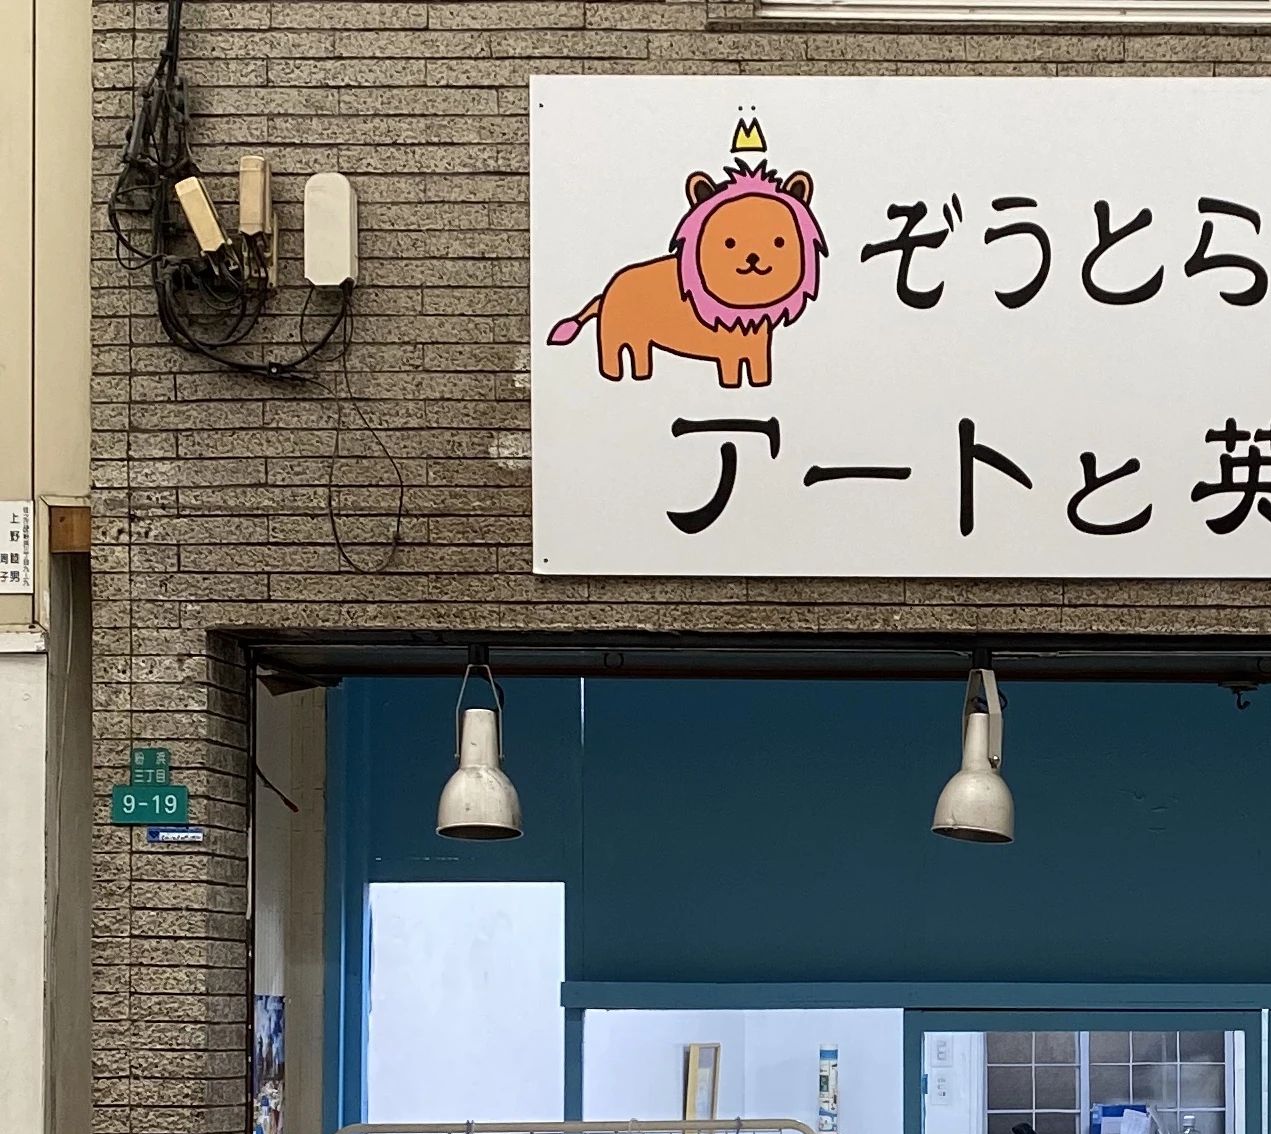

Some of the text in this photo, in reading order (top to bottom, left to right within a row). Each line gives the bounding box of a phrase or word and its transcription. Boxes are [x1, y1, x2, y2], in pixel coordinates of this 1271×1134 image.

[134, 769, 166, 783] 三丁目
[122, 794, 177, 814] 9-19
